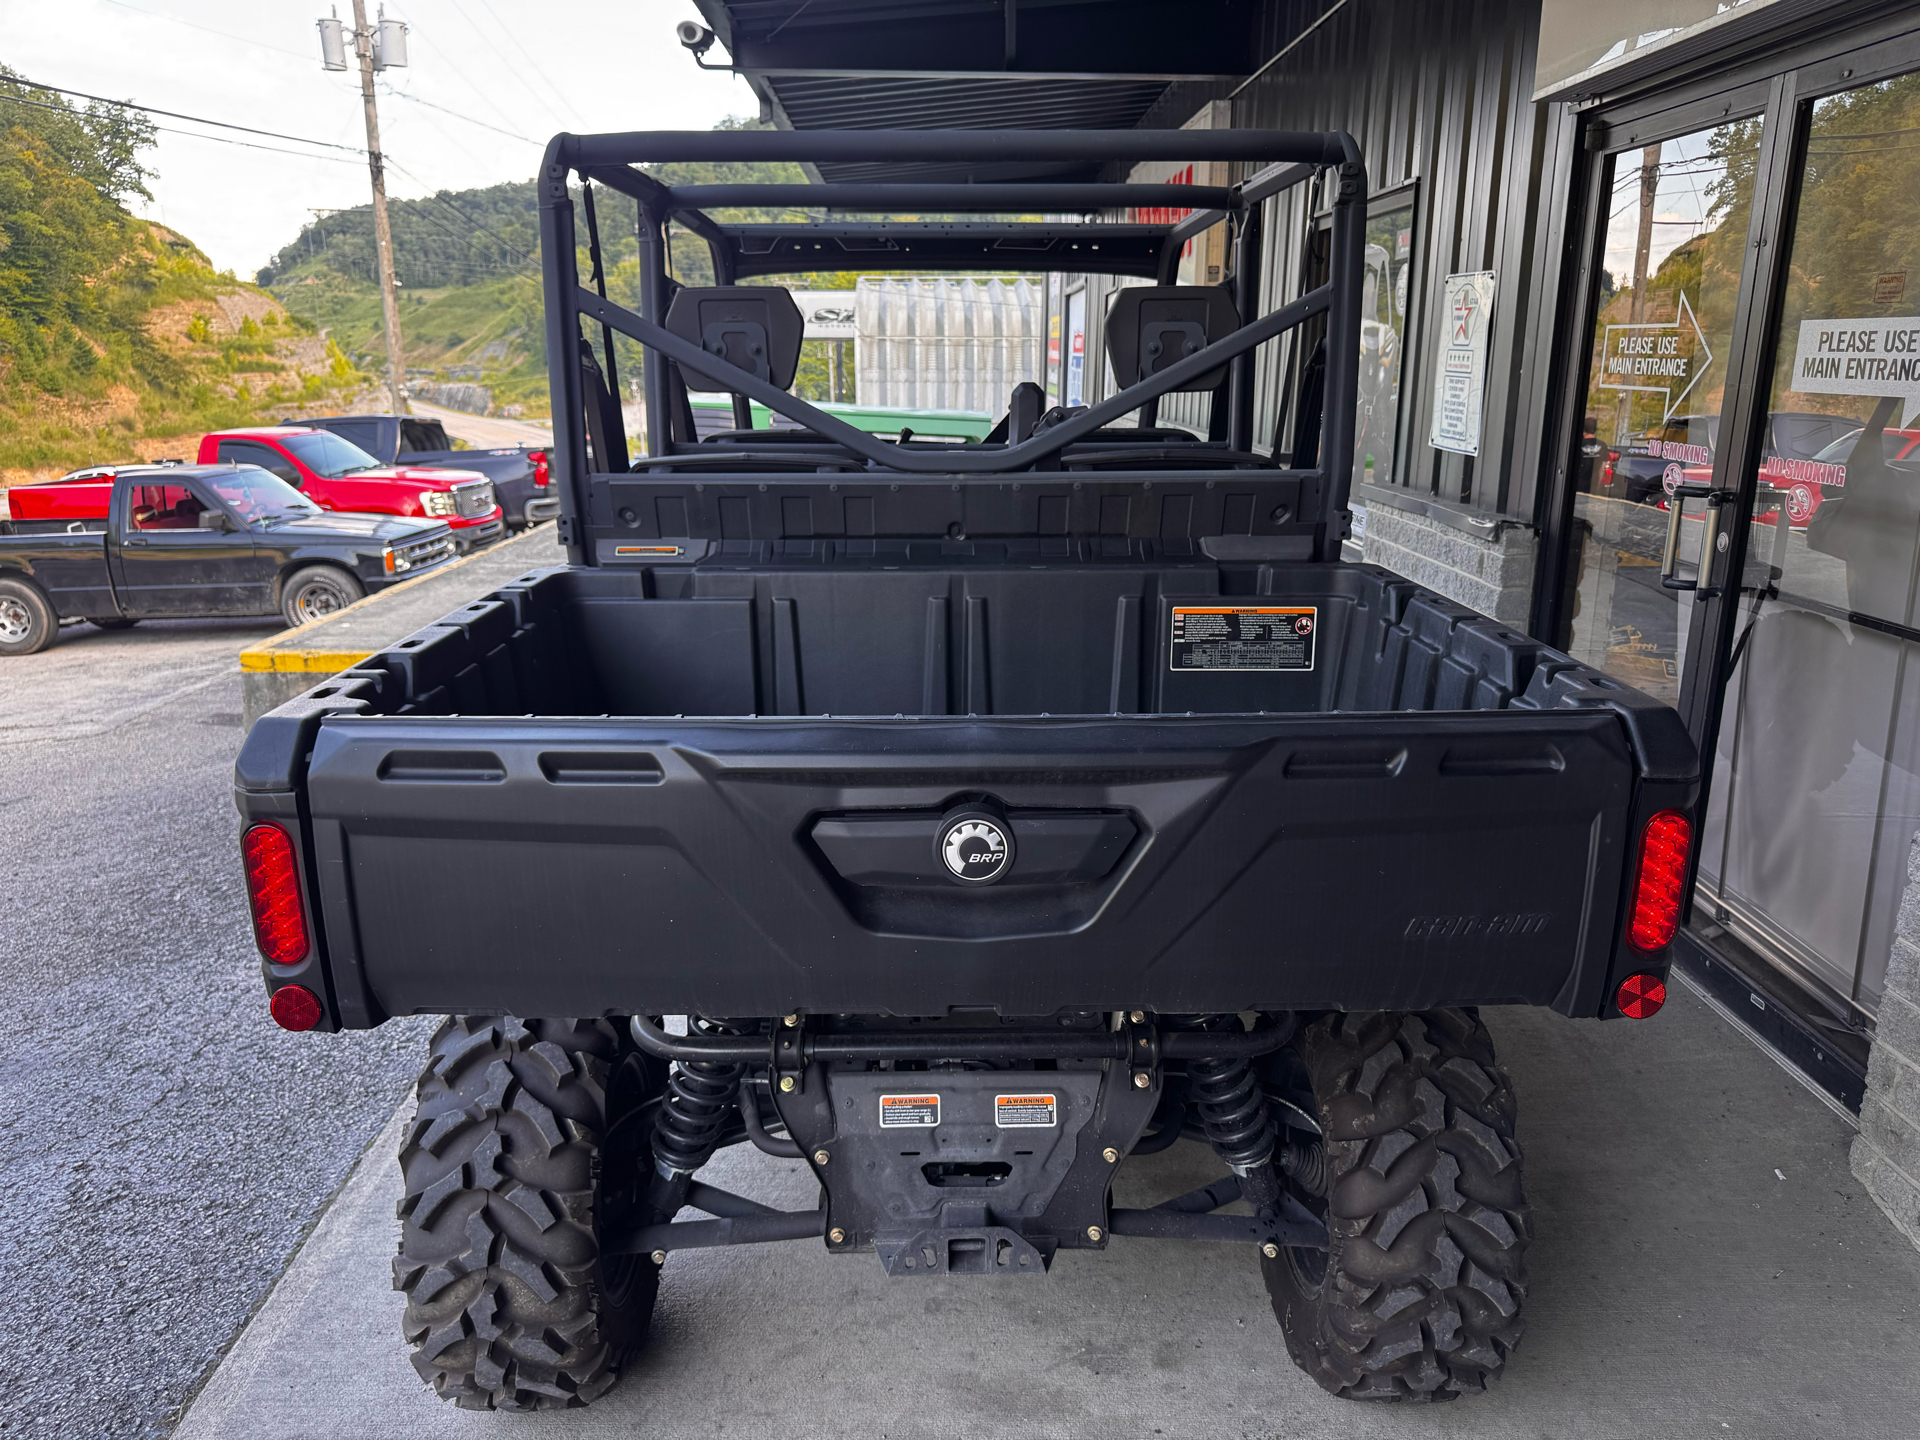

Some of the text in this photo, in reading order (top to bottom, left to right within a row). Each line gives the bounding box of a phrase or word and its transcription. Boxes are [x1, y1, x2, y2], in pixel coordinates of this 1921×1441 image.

[1618, 336, 1679, 354] PLEASE USE
[1818, 329, 1920, 353] PLEASE USE
[1608, 357, 1688, 377] MAIN ENTRANCE
[1802, 357, 1920, 381] MAIN ENTRANC
[1648, 440, 1708, 465] NO SMOKING
[1766, 456, 1846, 487] NO SMOKING
[968, 853, 1004, 863] BRP
